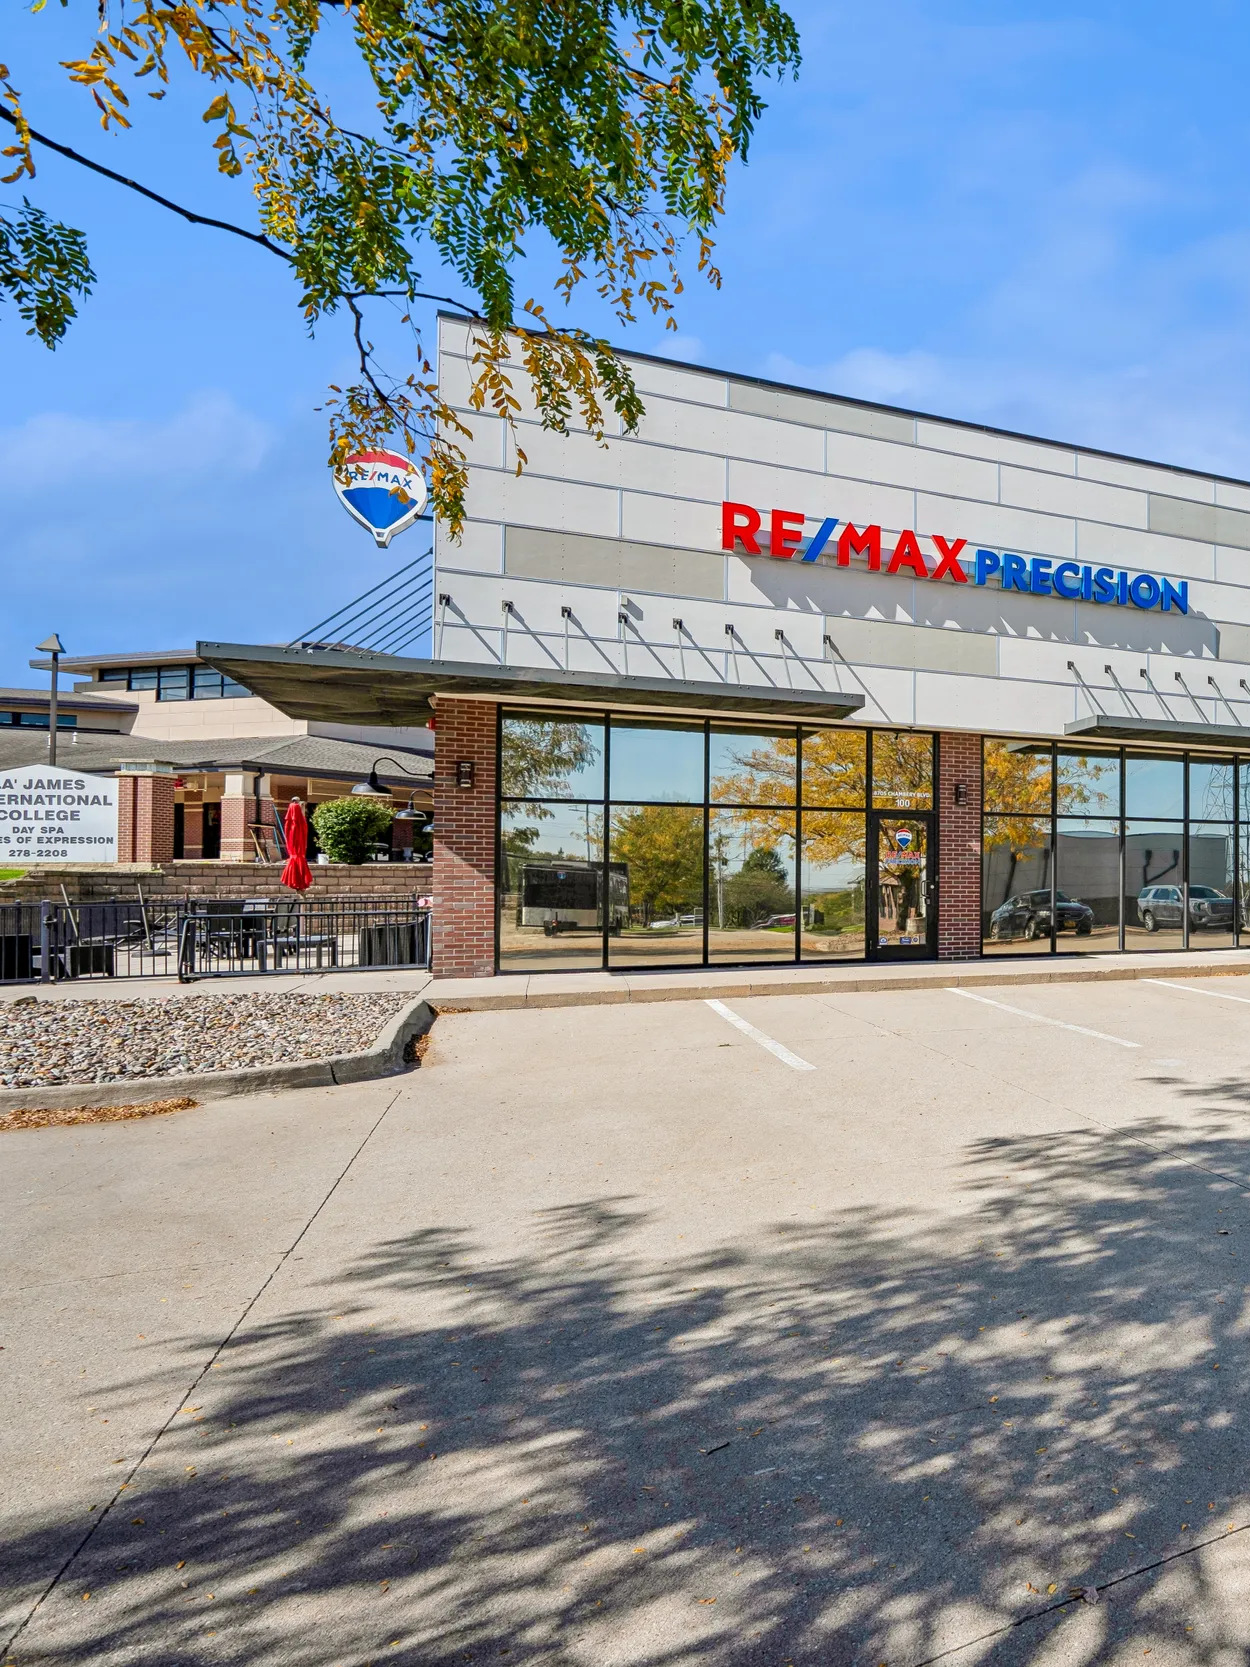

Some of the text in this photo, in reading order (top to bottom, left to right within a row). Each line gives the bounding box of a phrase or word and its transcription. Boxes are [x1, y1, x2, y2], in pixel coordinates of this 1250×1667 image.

[349, 471, 413, 490] RE/MAX
[722, 501, 1188, 614] RE/MAX PRECISION
[0, 779, 86, 790] A' JAMES
[895, 799, 910, 807] 100
[0, 810, 81, 821] COLLEGE
[12, 826, 64, 834] DAY SPA
[16, 836, 32, 844] OF
[37, 836, 114, 844] EXPRESSION
[9, 849, 68, 857] 278-2208
